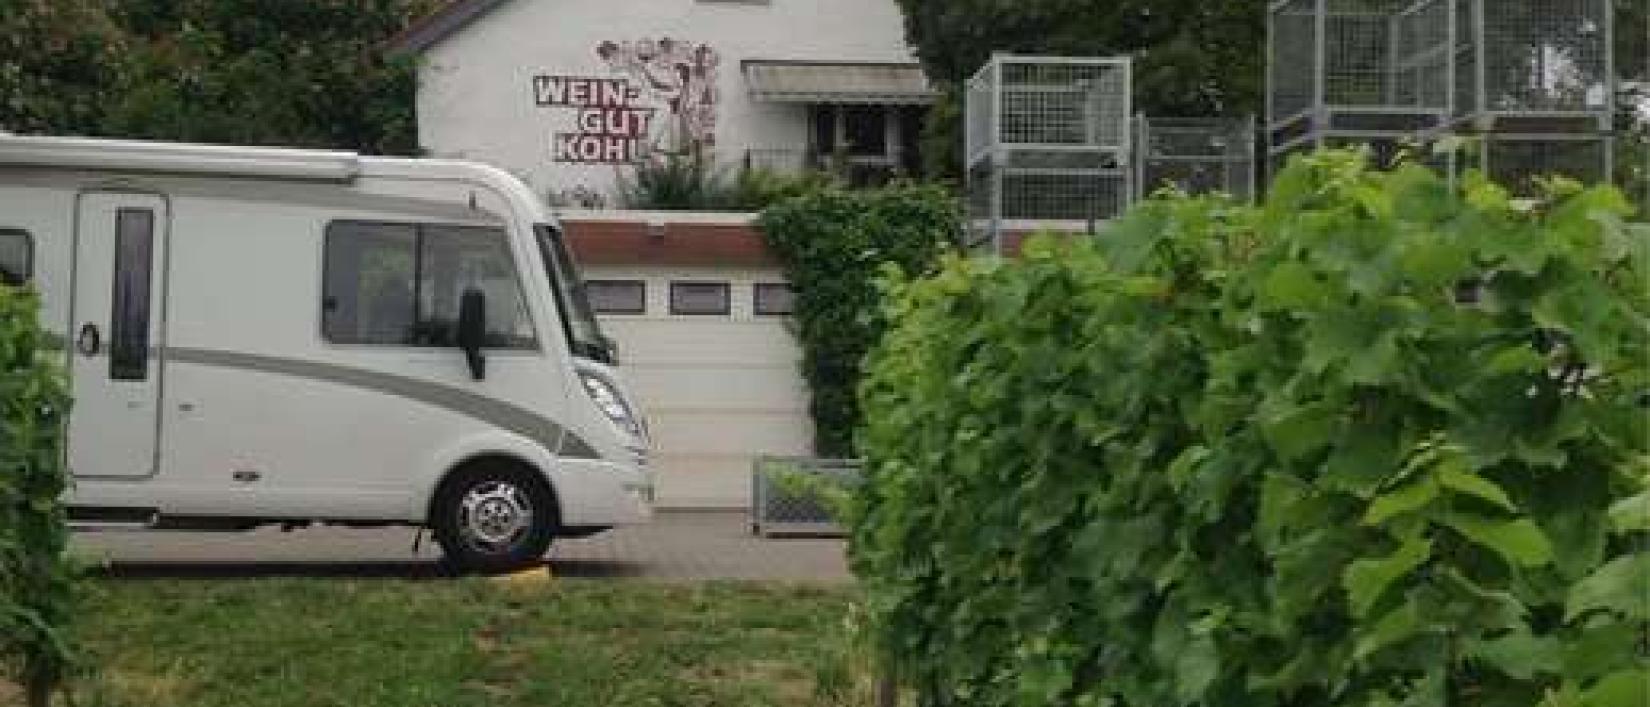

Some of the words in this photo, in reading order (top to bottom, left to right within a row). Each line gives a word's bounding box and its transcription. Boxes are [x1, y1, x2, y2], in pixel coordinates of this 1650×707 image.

[534, 77, 641, 106] WEIN-
[579, 107, 653, 134] GUT
[554, 135, 650, 163] KOHL
